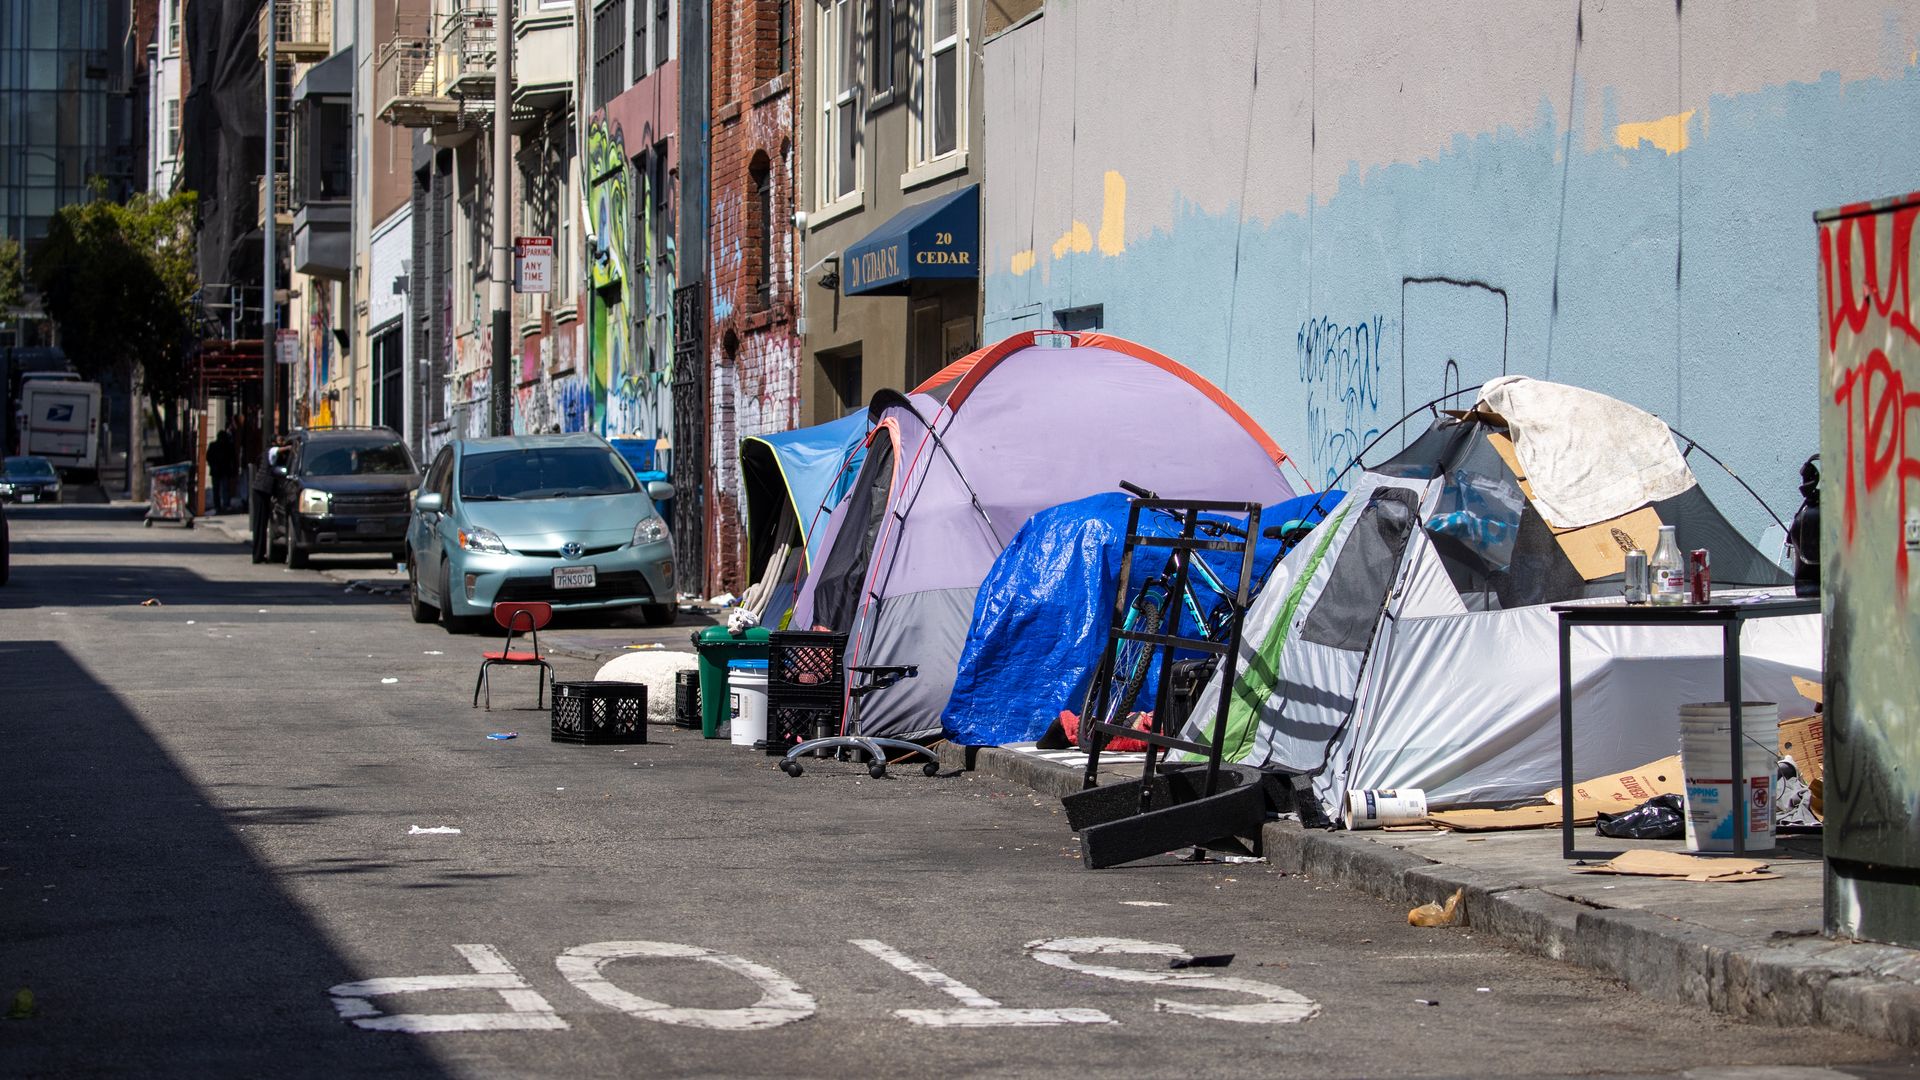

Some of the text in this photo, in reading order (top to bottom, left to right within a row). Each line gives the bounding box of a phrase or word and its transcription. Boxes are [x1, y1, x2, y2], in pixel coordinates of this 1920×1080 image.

[935, 232, 953, 245] 20
[527, 248, 551, 256] PARKING
[916, 251, 970, 264] CEDAR
[525, 261, 542, 271] ANY
[862, 248, 887, 284] CEDAR
[524, 272, 543, 281] TIME
[330, 936, 1321, 1034] STOP
